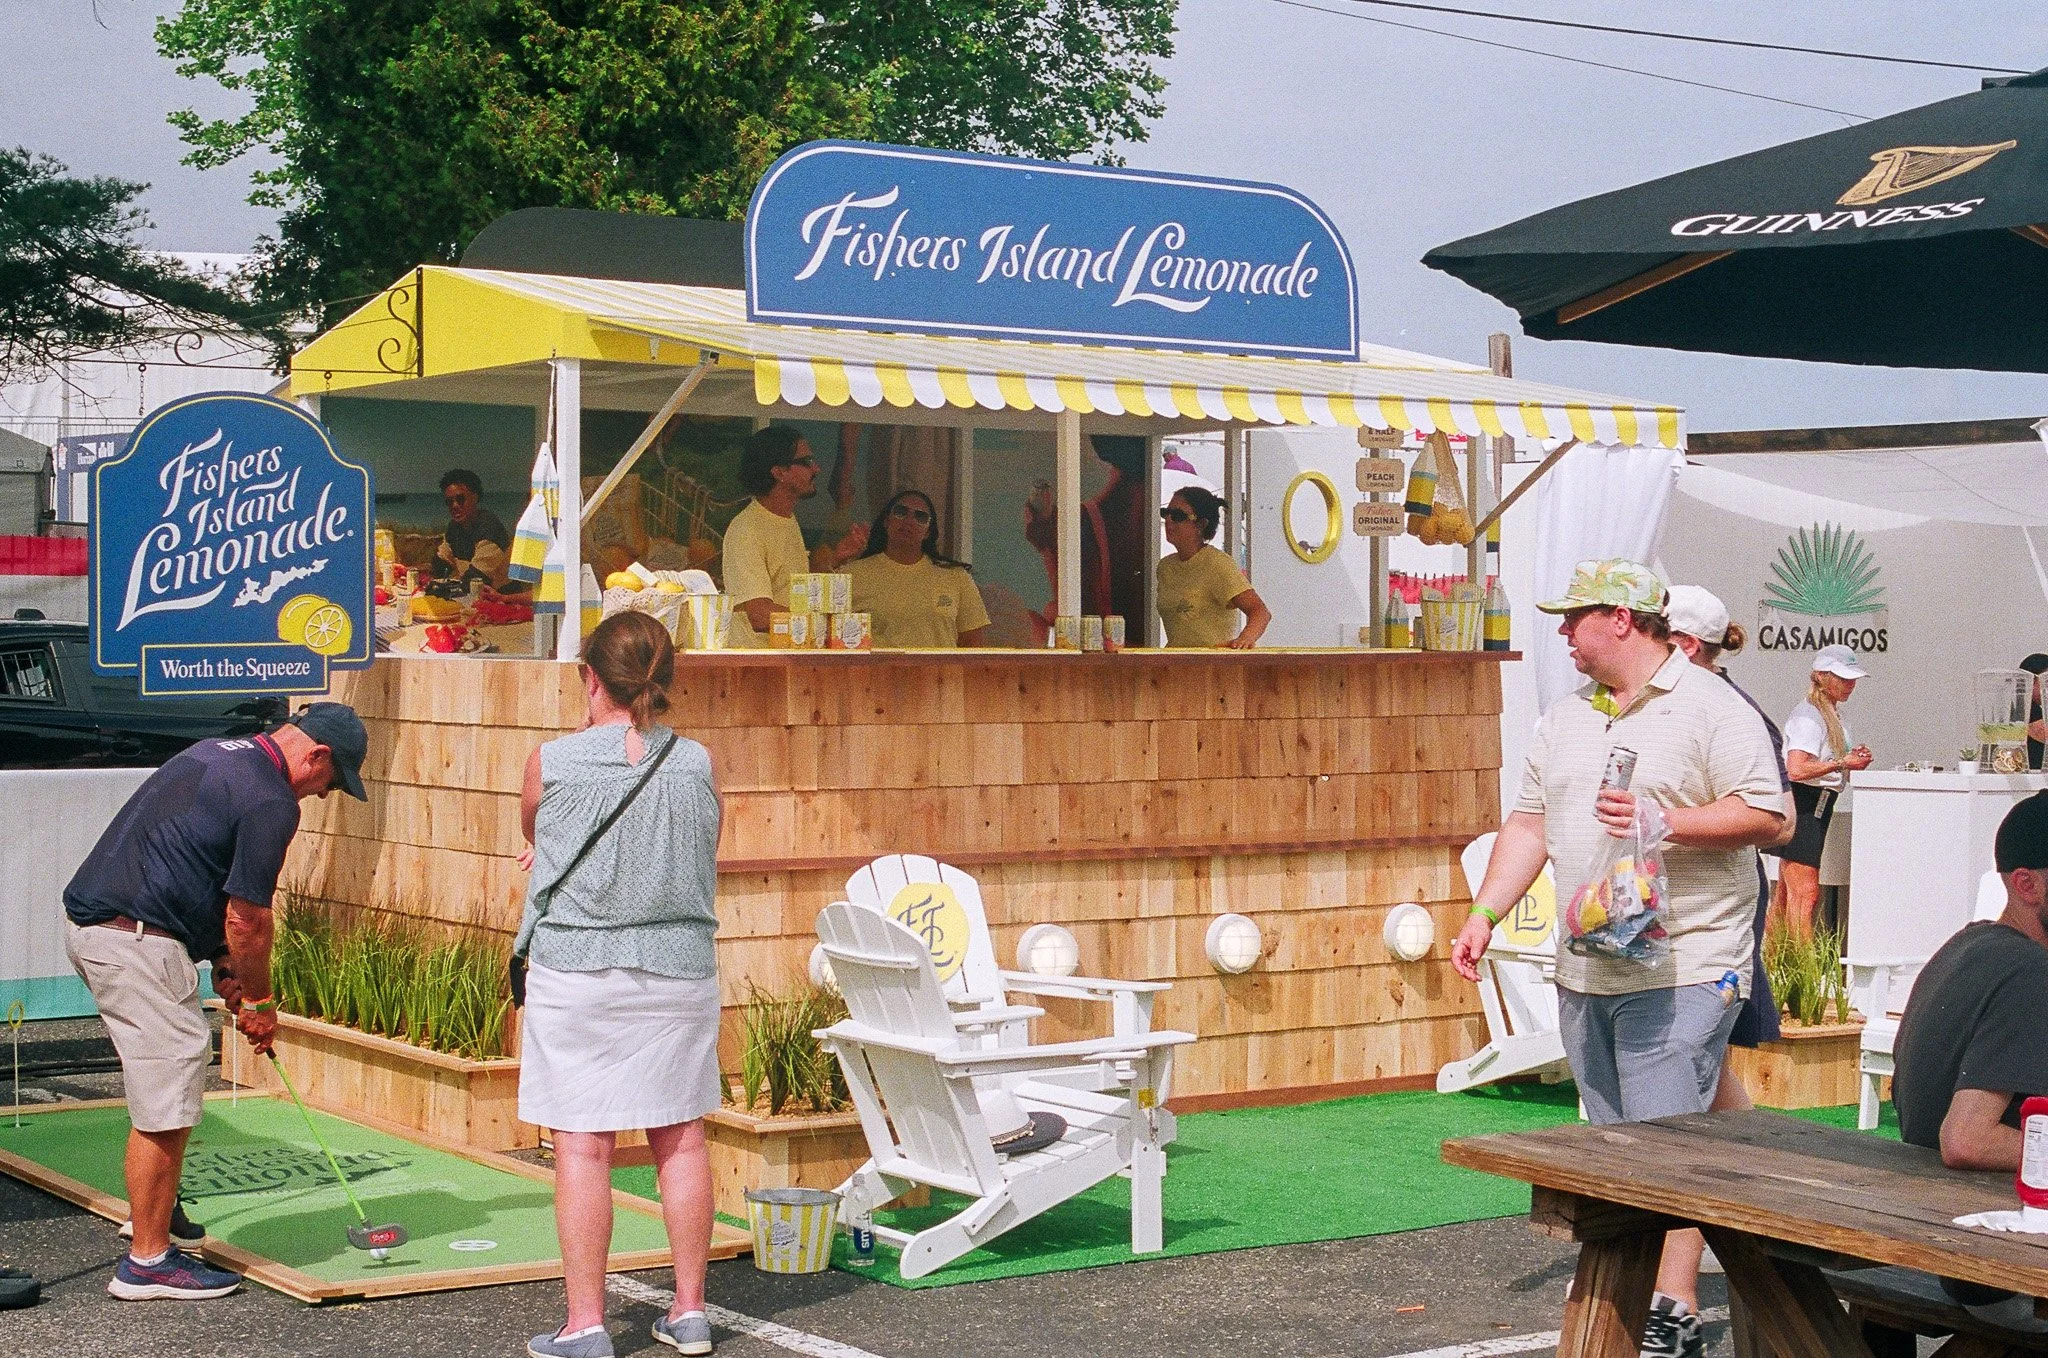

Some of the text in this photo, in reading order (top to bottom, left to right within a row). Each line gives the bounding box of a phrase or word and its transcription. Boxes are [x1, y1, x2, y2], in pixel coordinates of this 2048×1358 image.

[1671, 198, 1985, 236] GUINNESS
[794, 185, 1319, 313] Fishers Island Lemonade
[159, 427, 283, 518] Fishers
[1366, 473, 1395, 481] PEACH
[188, 466, 303, 546] Island
[1358, 516, 1400, 525] ORIGINAL
[1759, 625, 1888, 652] CASAMIGOS
[160, 658, 310, 681] Worth the Squeeze
